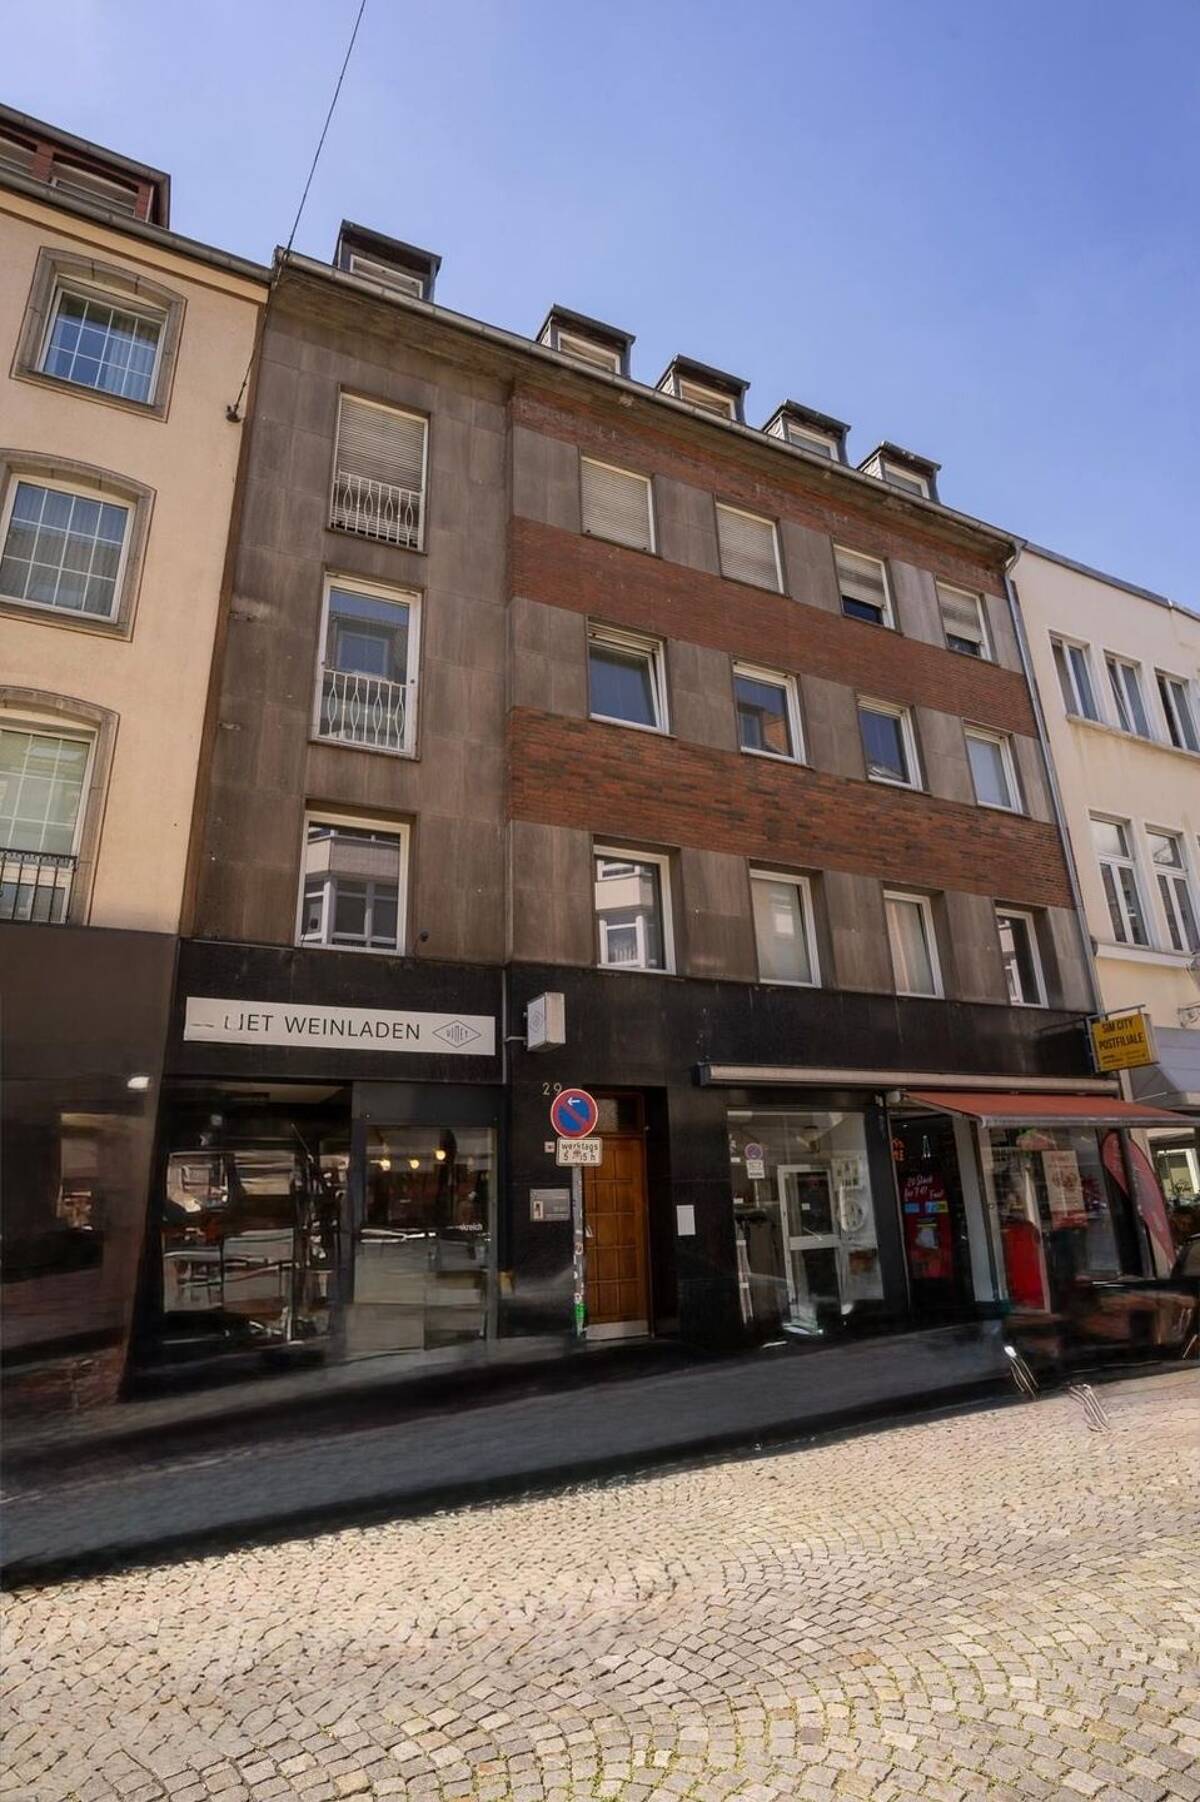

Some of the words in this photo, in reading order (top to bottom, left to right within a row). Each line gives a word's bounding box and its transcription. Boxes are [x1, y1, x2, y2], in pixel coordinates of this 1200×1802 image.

[284, 1015, 420, 1041] WEINLADEN
[1098, 1033, 1144, 1050] POSTFILIALE
[542, 1082, 562, 1096] 29
